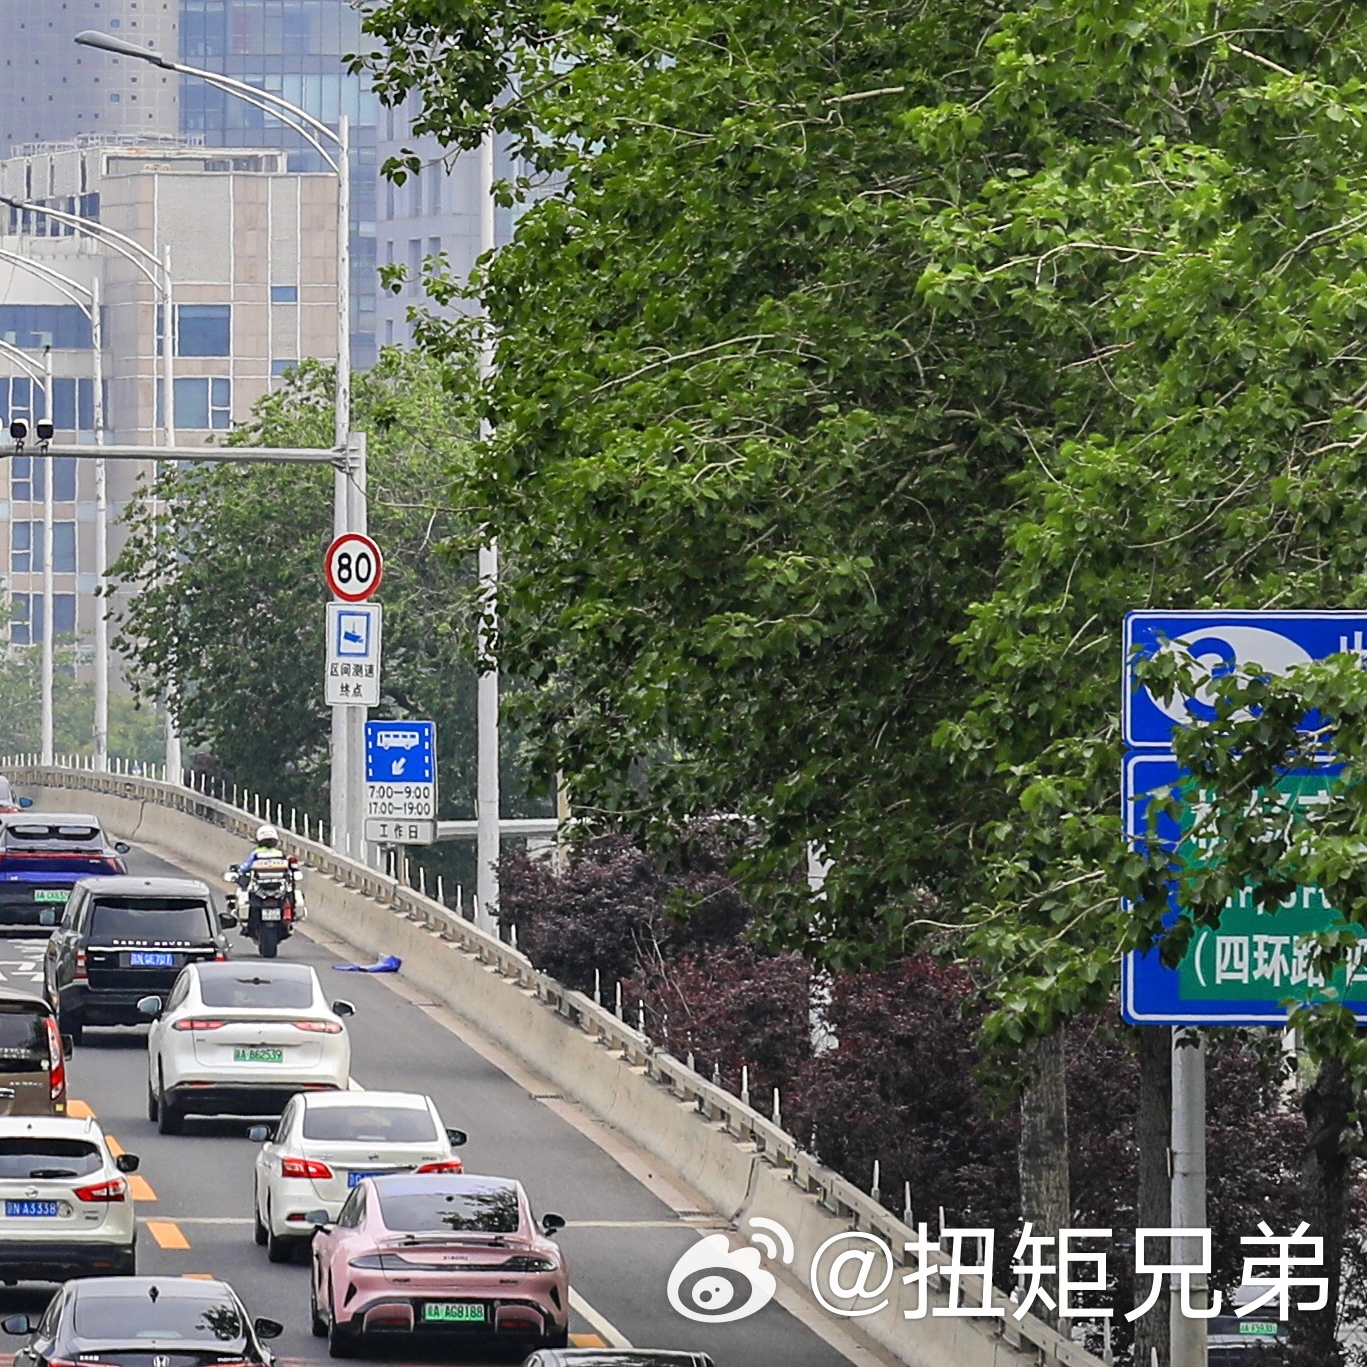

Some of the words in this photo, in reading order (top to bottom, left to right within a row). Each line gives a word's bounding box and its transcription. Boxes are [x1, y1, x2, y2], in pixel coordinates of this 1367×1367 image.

[337, 552, 372, 583] 80
[330, 662, 374, 678] 区间测速
[339, 682, 364, 697] 终点
[379, 823, 418, 840] 工作日
